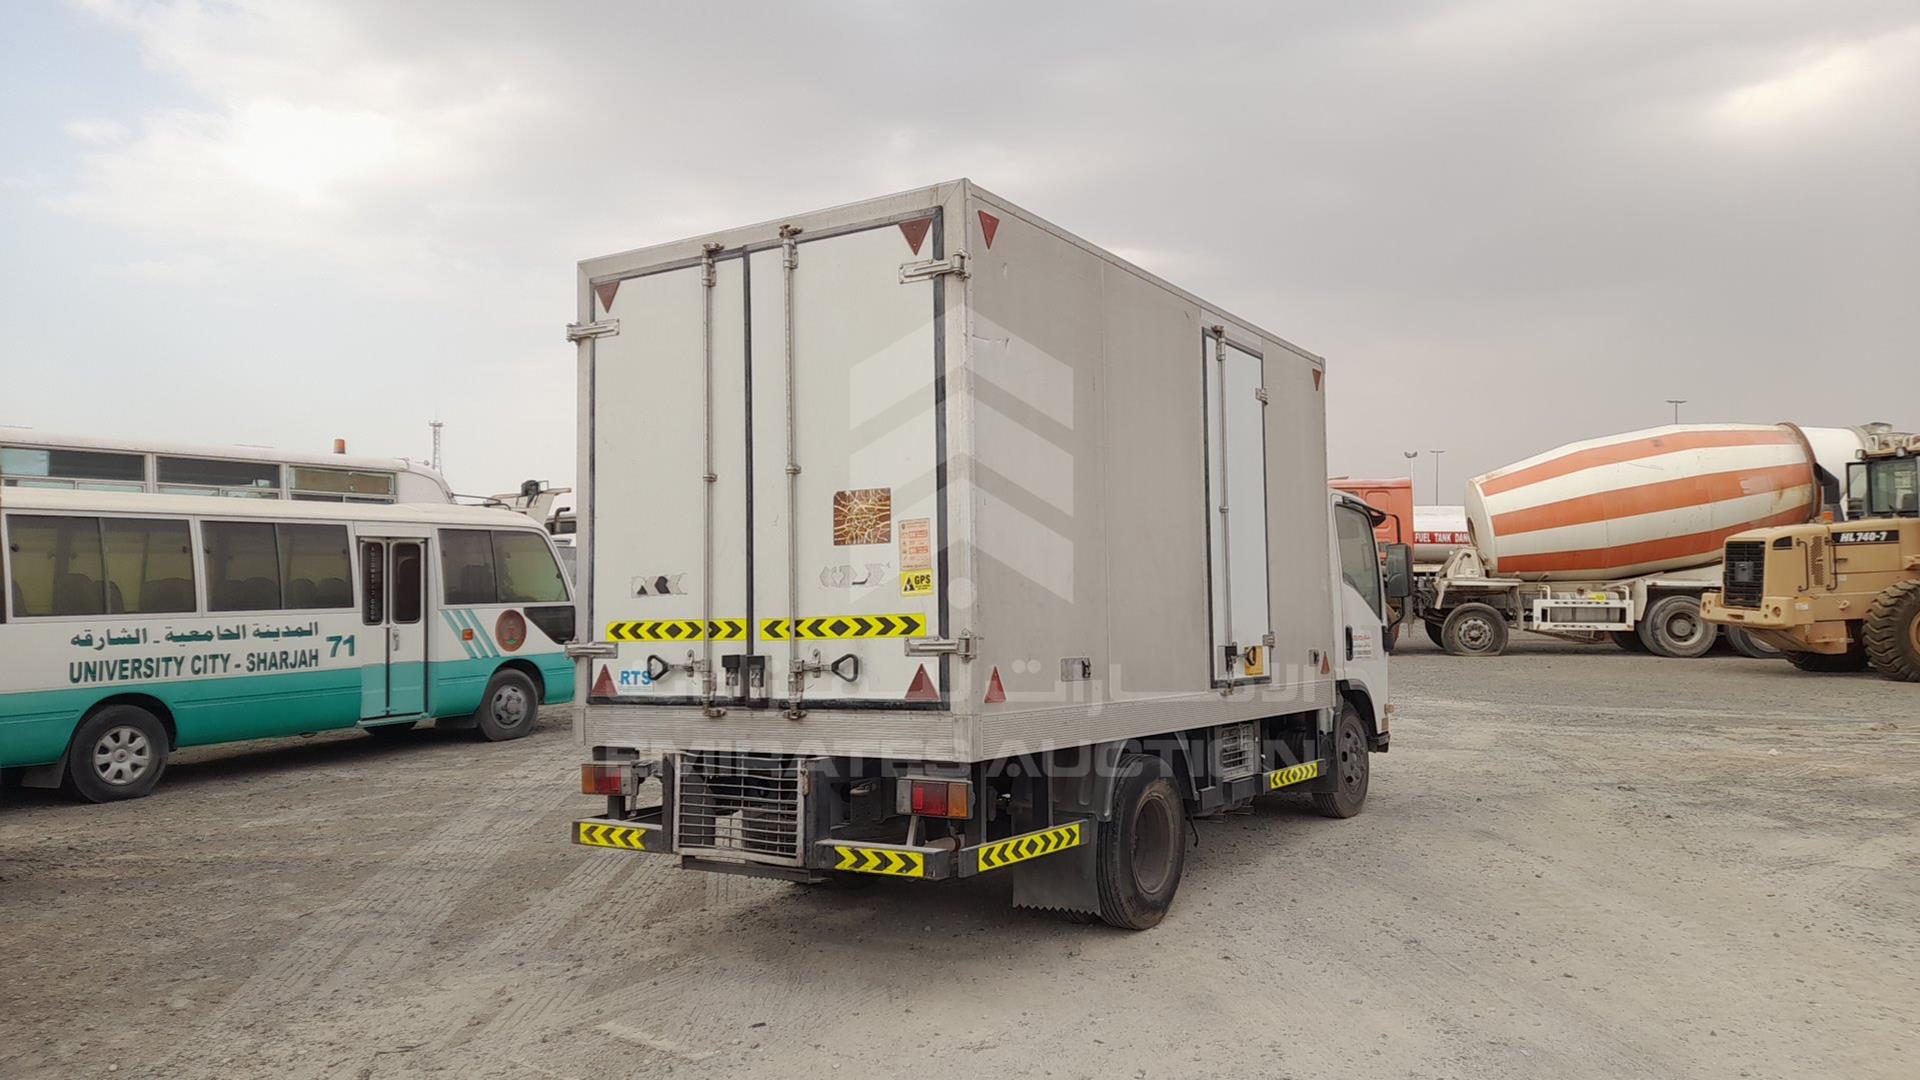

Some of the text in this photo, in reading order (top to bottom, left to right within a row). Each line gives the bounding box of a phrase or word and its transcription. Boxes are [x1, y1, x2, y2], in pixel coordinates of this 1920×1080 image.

[1415, 533, 1470, 542] FUEL TANK DAN
[914, 574, 931, 585] GPS
[252, 621, 319, 642] المدينة
[326, 634, 356, 658] 71
[69, 655, 185, 683] UNIVERSITY
[191, 653, 231, 675] CITY
[246, 649, 319, 672] SHARJAH
[620, 670, 651, 685] RTS
